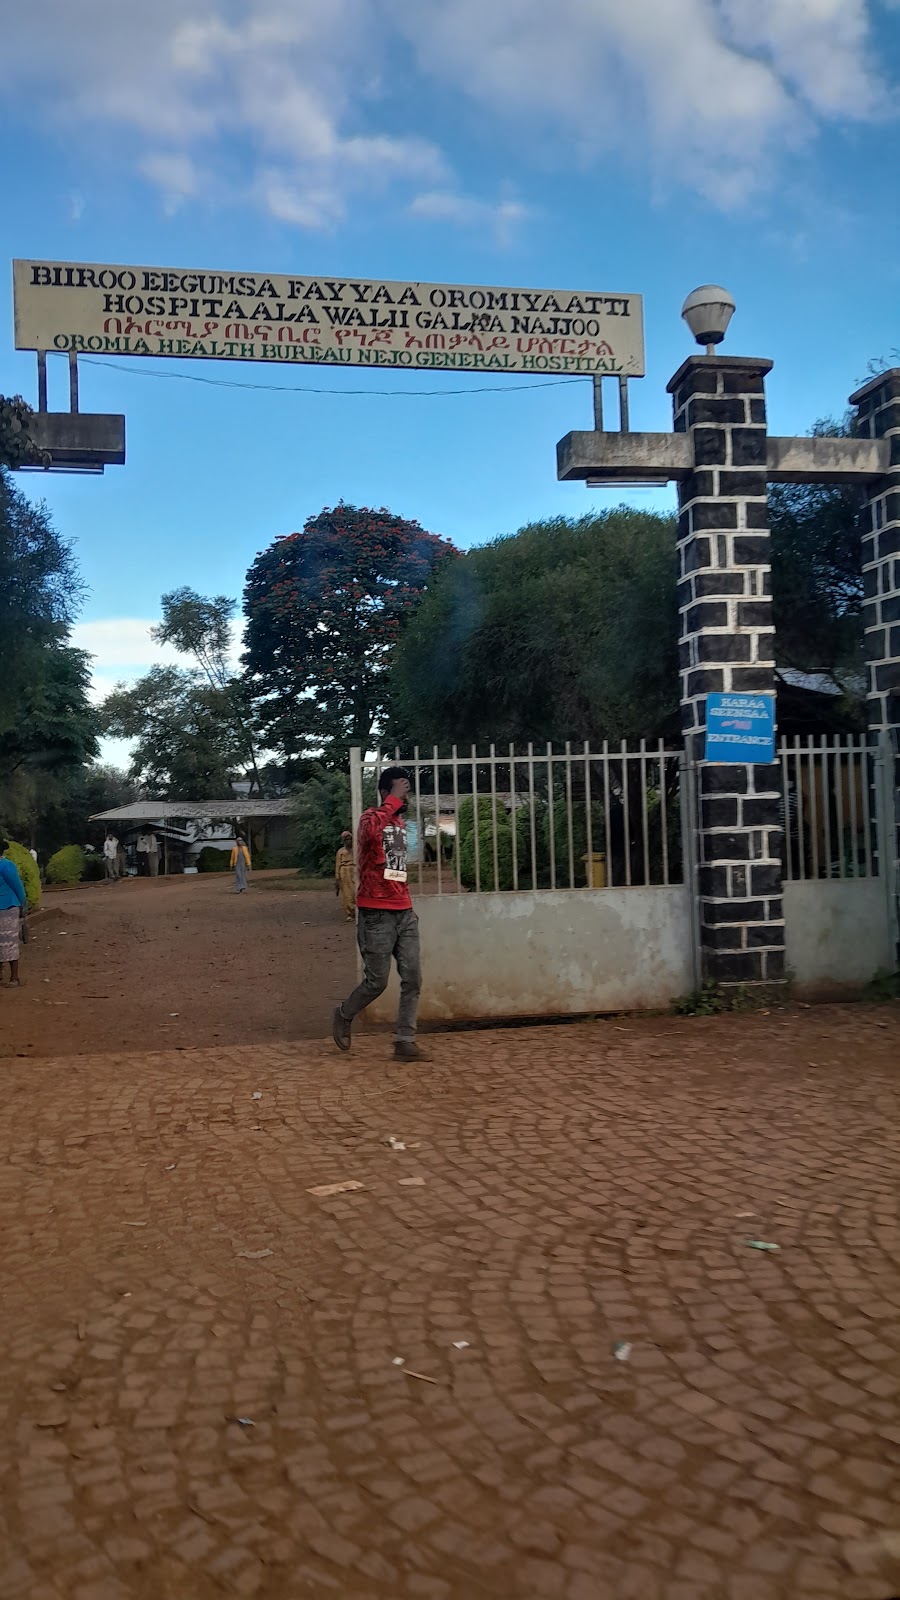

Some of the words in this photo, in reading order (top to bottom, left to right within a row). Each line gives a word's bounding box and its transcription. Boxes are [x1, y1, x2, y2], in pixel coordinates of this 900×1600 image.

[30, 265, 136, 290] BIIROO
[141, 272, 281, 298] EEGUMSA
[287, 281, 422, 306] FAYYAA
[429, 289, 631, 316] OROMIYAATTI
[103, 294, 320, 324] HOSPITAALA
[322, 306, 409, 328] WALII
[511, 316, 600, 336] NAJJOO
[53, 334, 153, 354] OROMIA
[158, 338, 256, 357] HEALTH
[260, 343, 352, 362] BUREAU
[357, 349, 412, 365] NEJO
[415, 350, 518, 369] GENERAL
[521, 355, 623, 372] HOSPITAL
